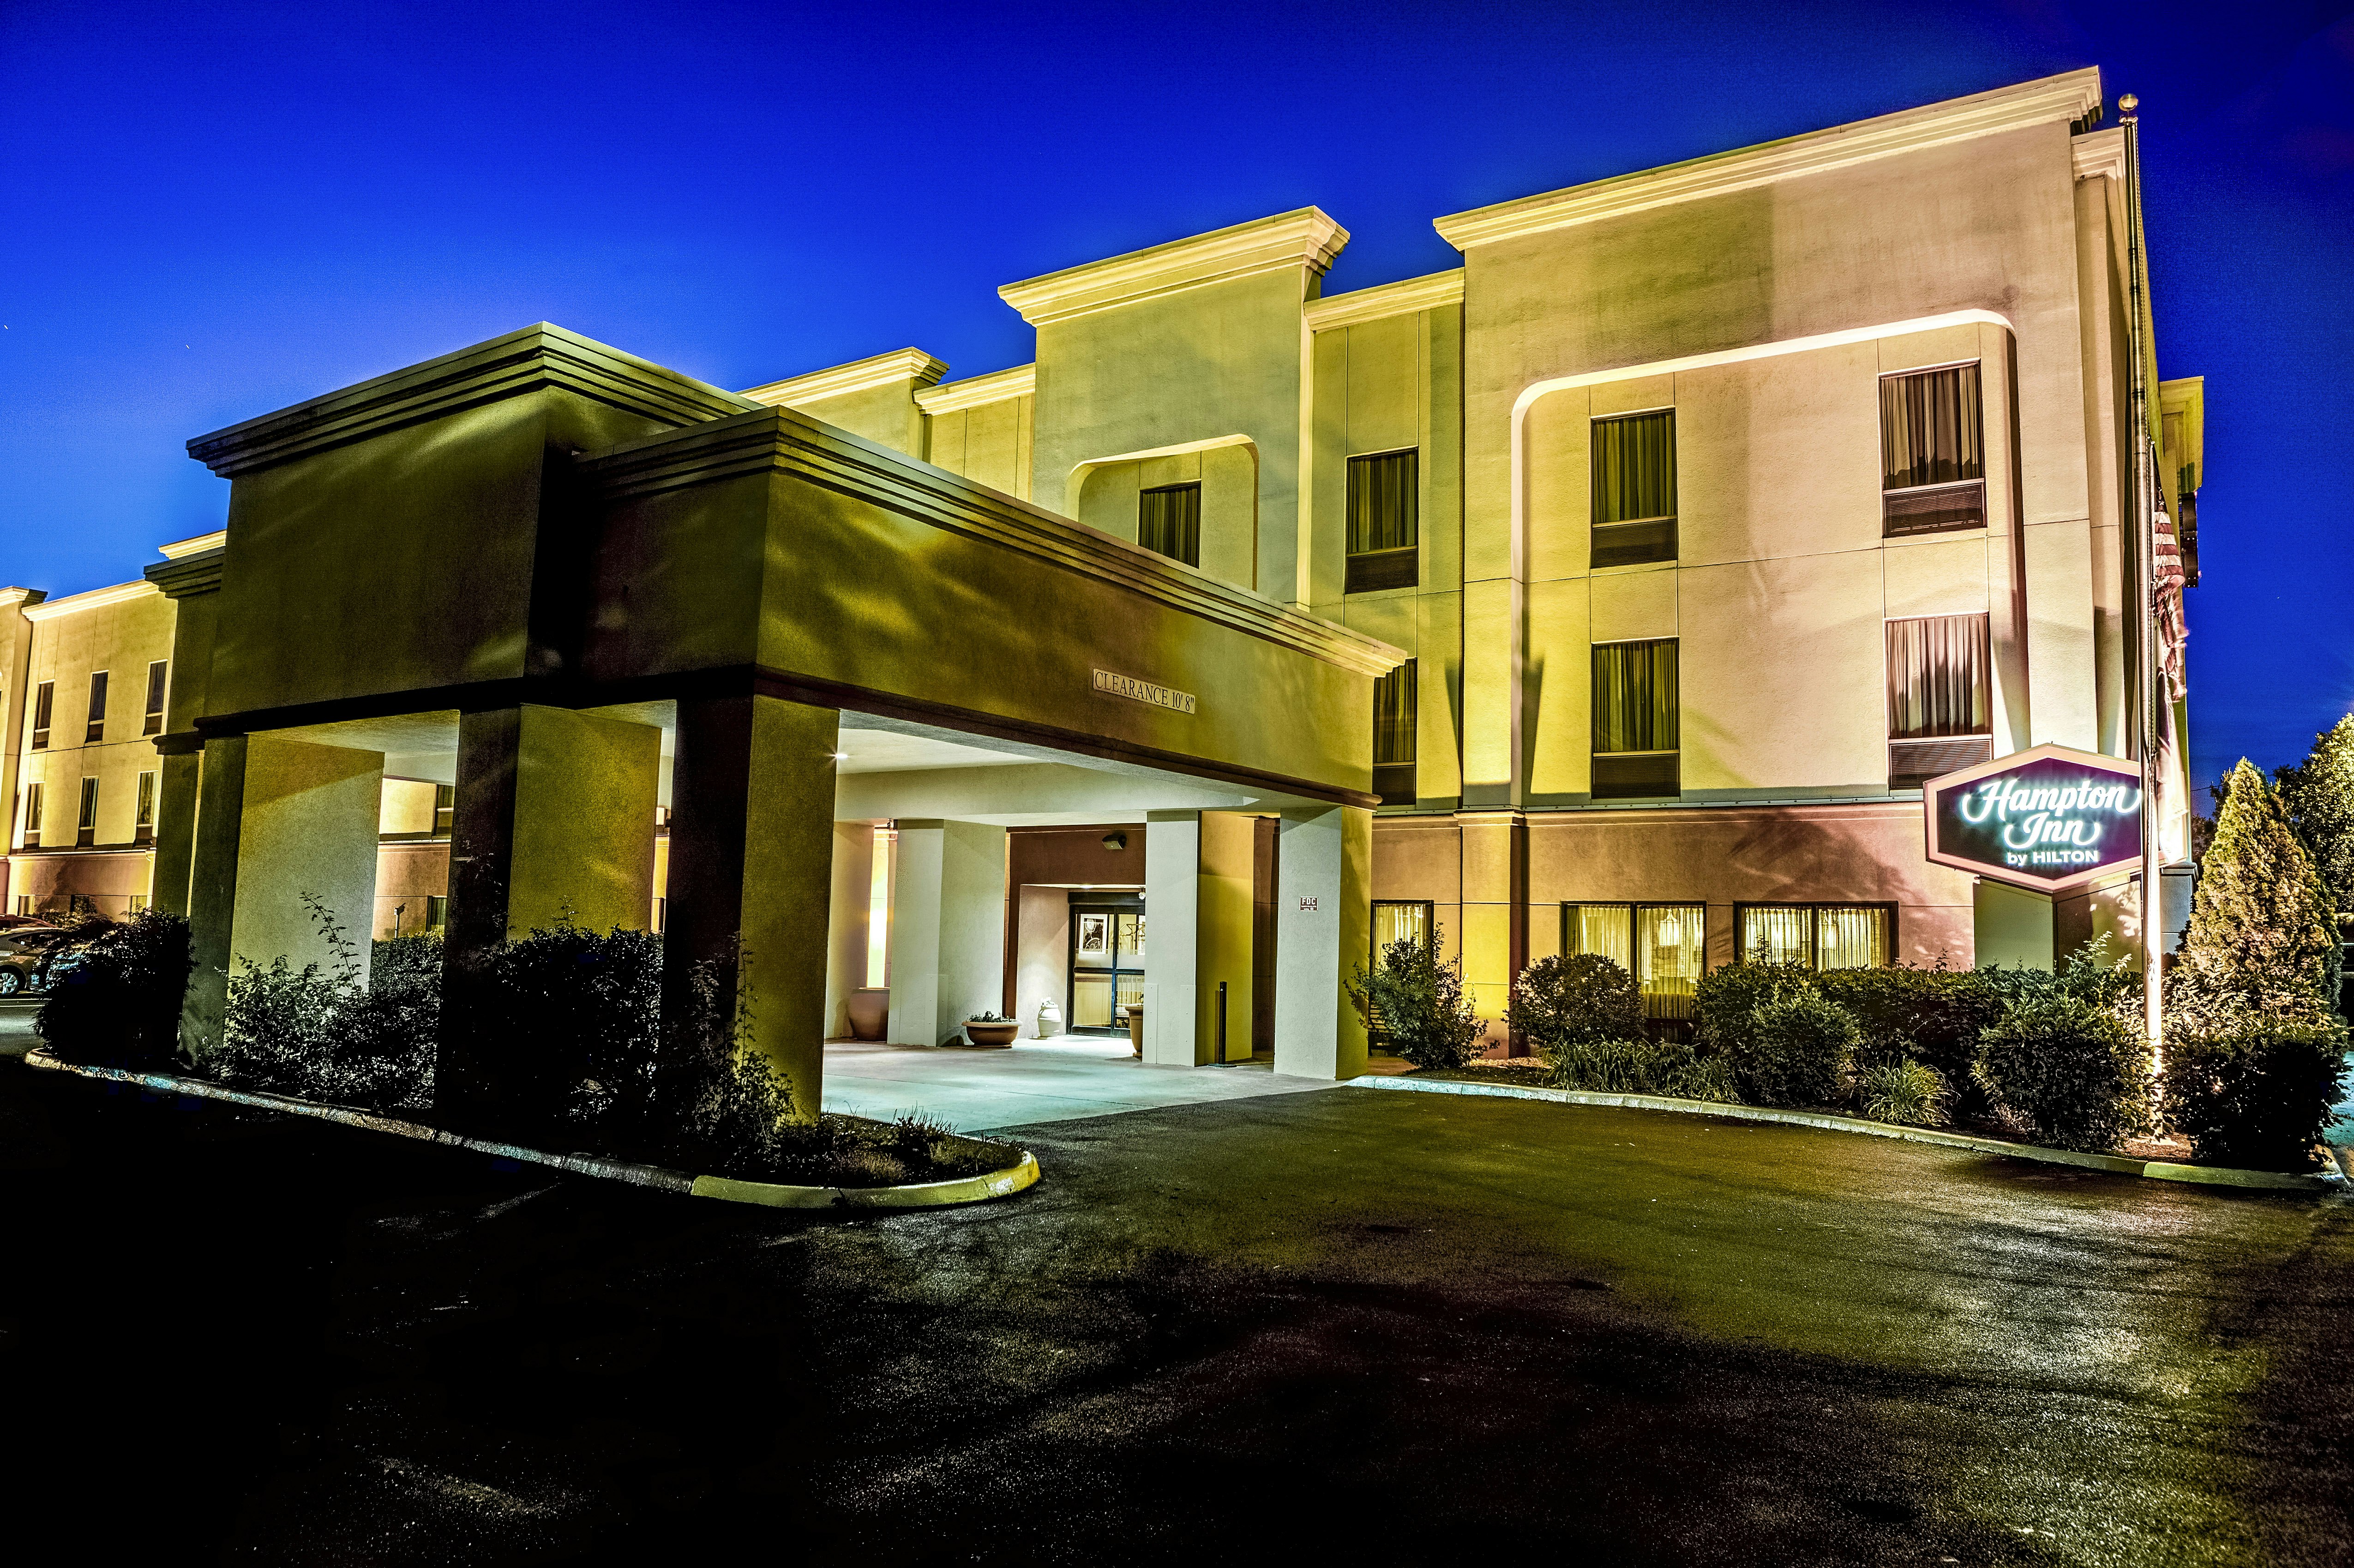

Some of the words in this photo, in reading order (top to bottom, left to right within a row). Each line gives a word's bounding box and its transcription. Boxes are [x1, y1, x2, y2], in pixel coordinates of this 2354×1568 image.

[1095, 671, 1168, 705] CLEARANCE
[1172, 691, 1183, 708] 10'
[1185, 695, 1194, 711] 8"
[1962, 779, 2142, 823] Hampton
[2004, 812, 2101, 849] Inn
[2007, 851, 2027, 866] by
[2033, 850, 2099, 864] HILTON
